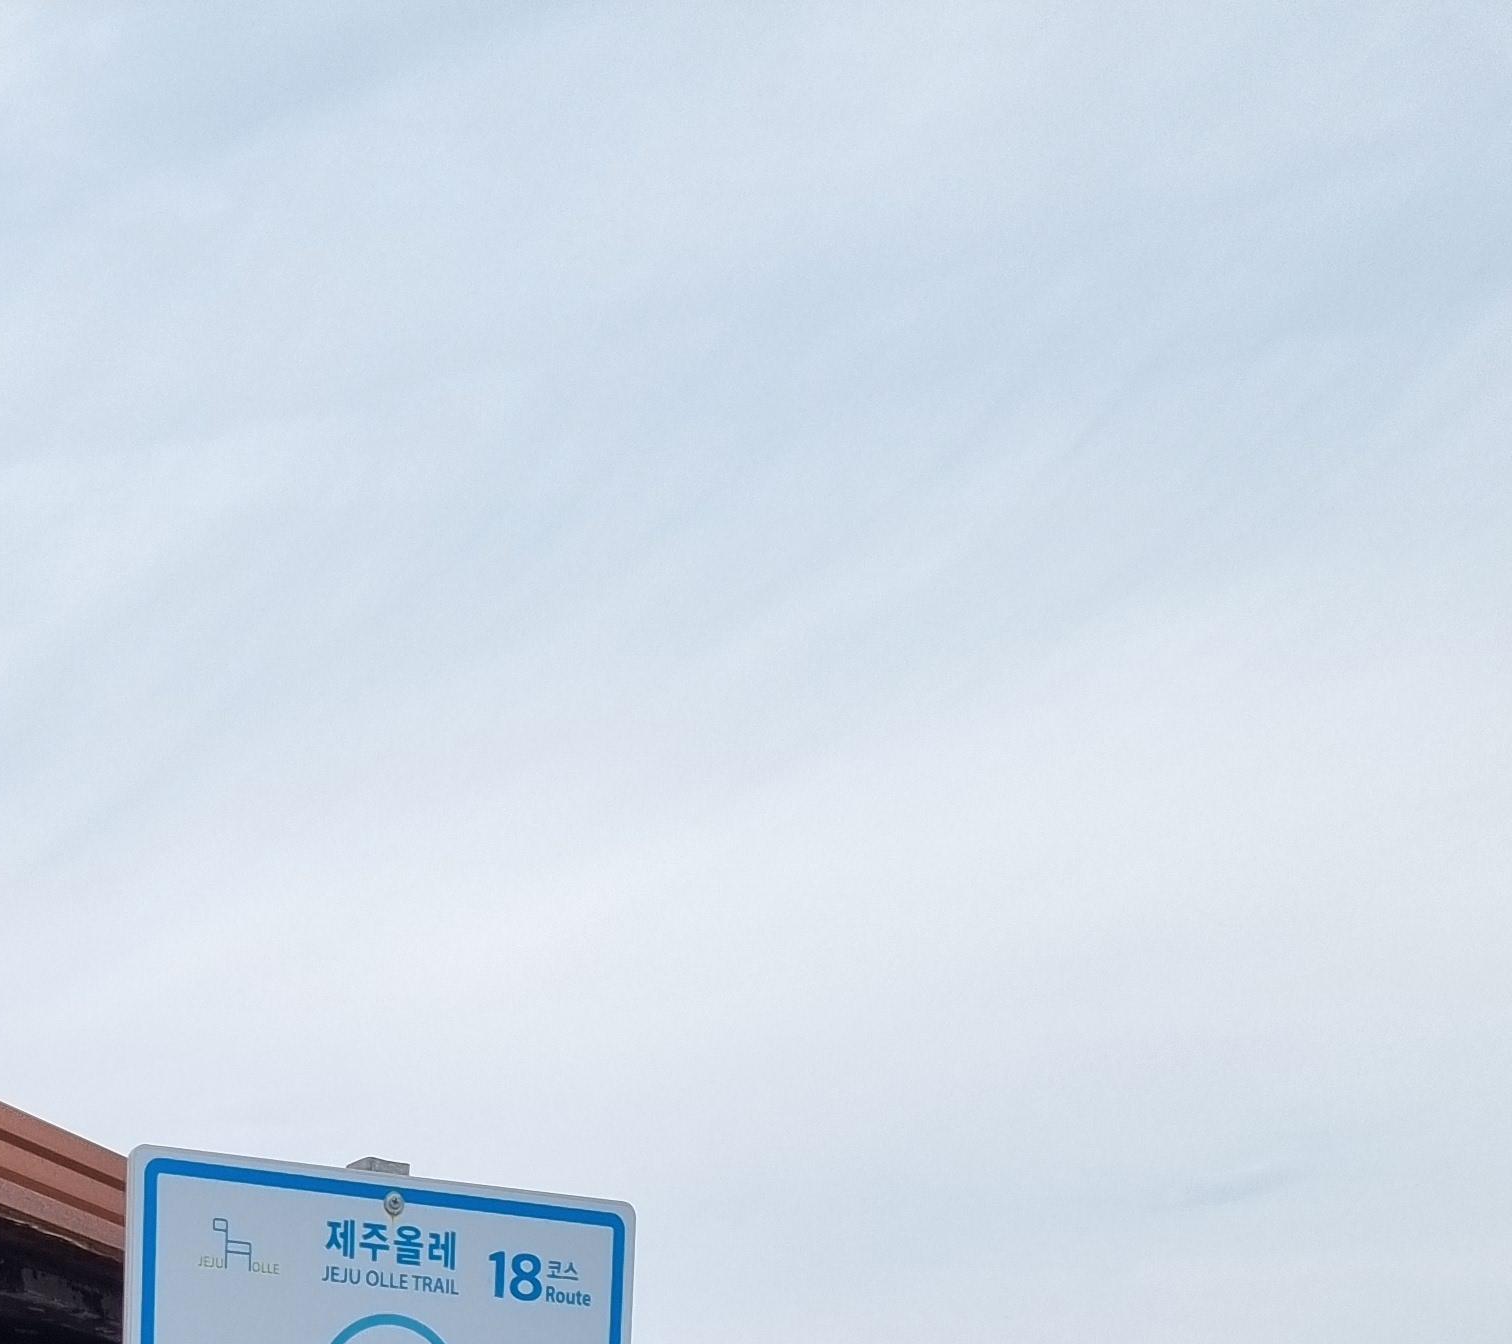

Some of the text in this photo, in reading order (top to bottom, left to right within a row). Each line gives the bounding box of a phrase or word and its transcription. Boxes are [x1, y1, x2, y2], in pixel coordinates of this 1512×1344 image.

[325, 1218, 457, 1271] 제주올레
[198, 1255, 224, 1270] JEJU
[251, 1260, 280, 1276] OLLE
[546, 1259, 579, 1281] 코스
[322, 1266, 459, 1296] JEJU OLLE TRAIL
[488, 1250, 542, 1302] 18
[545, 1285, 591, 1307] Route
